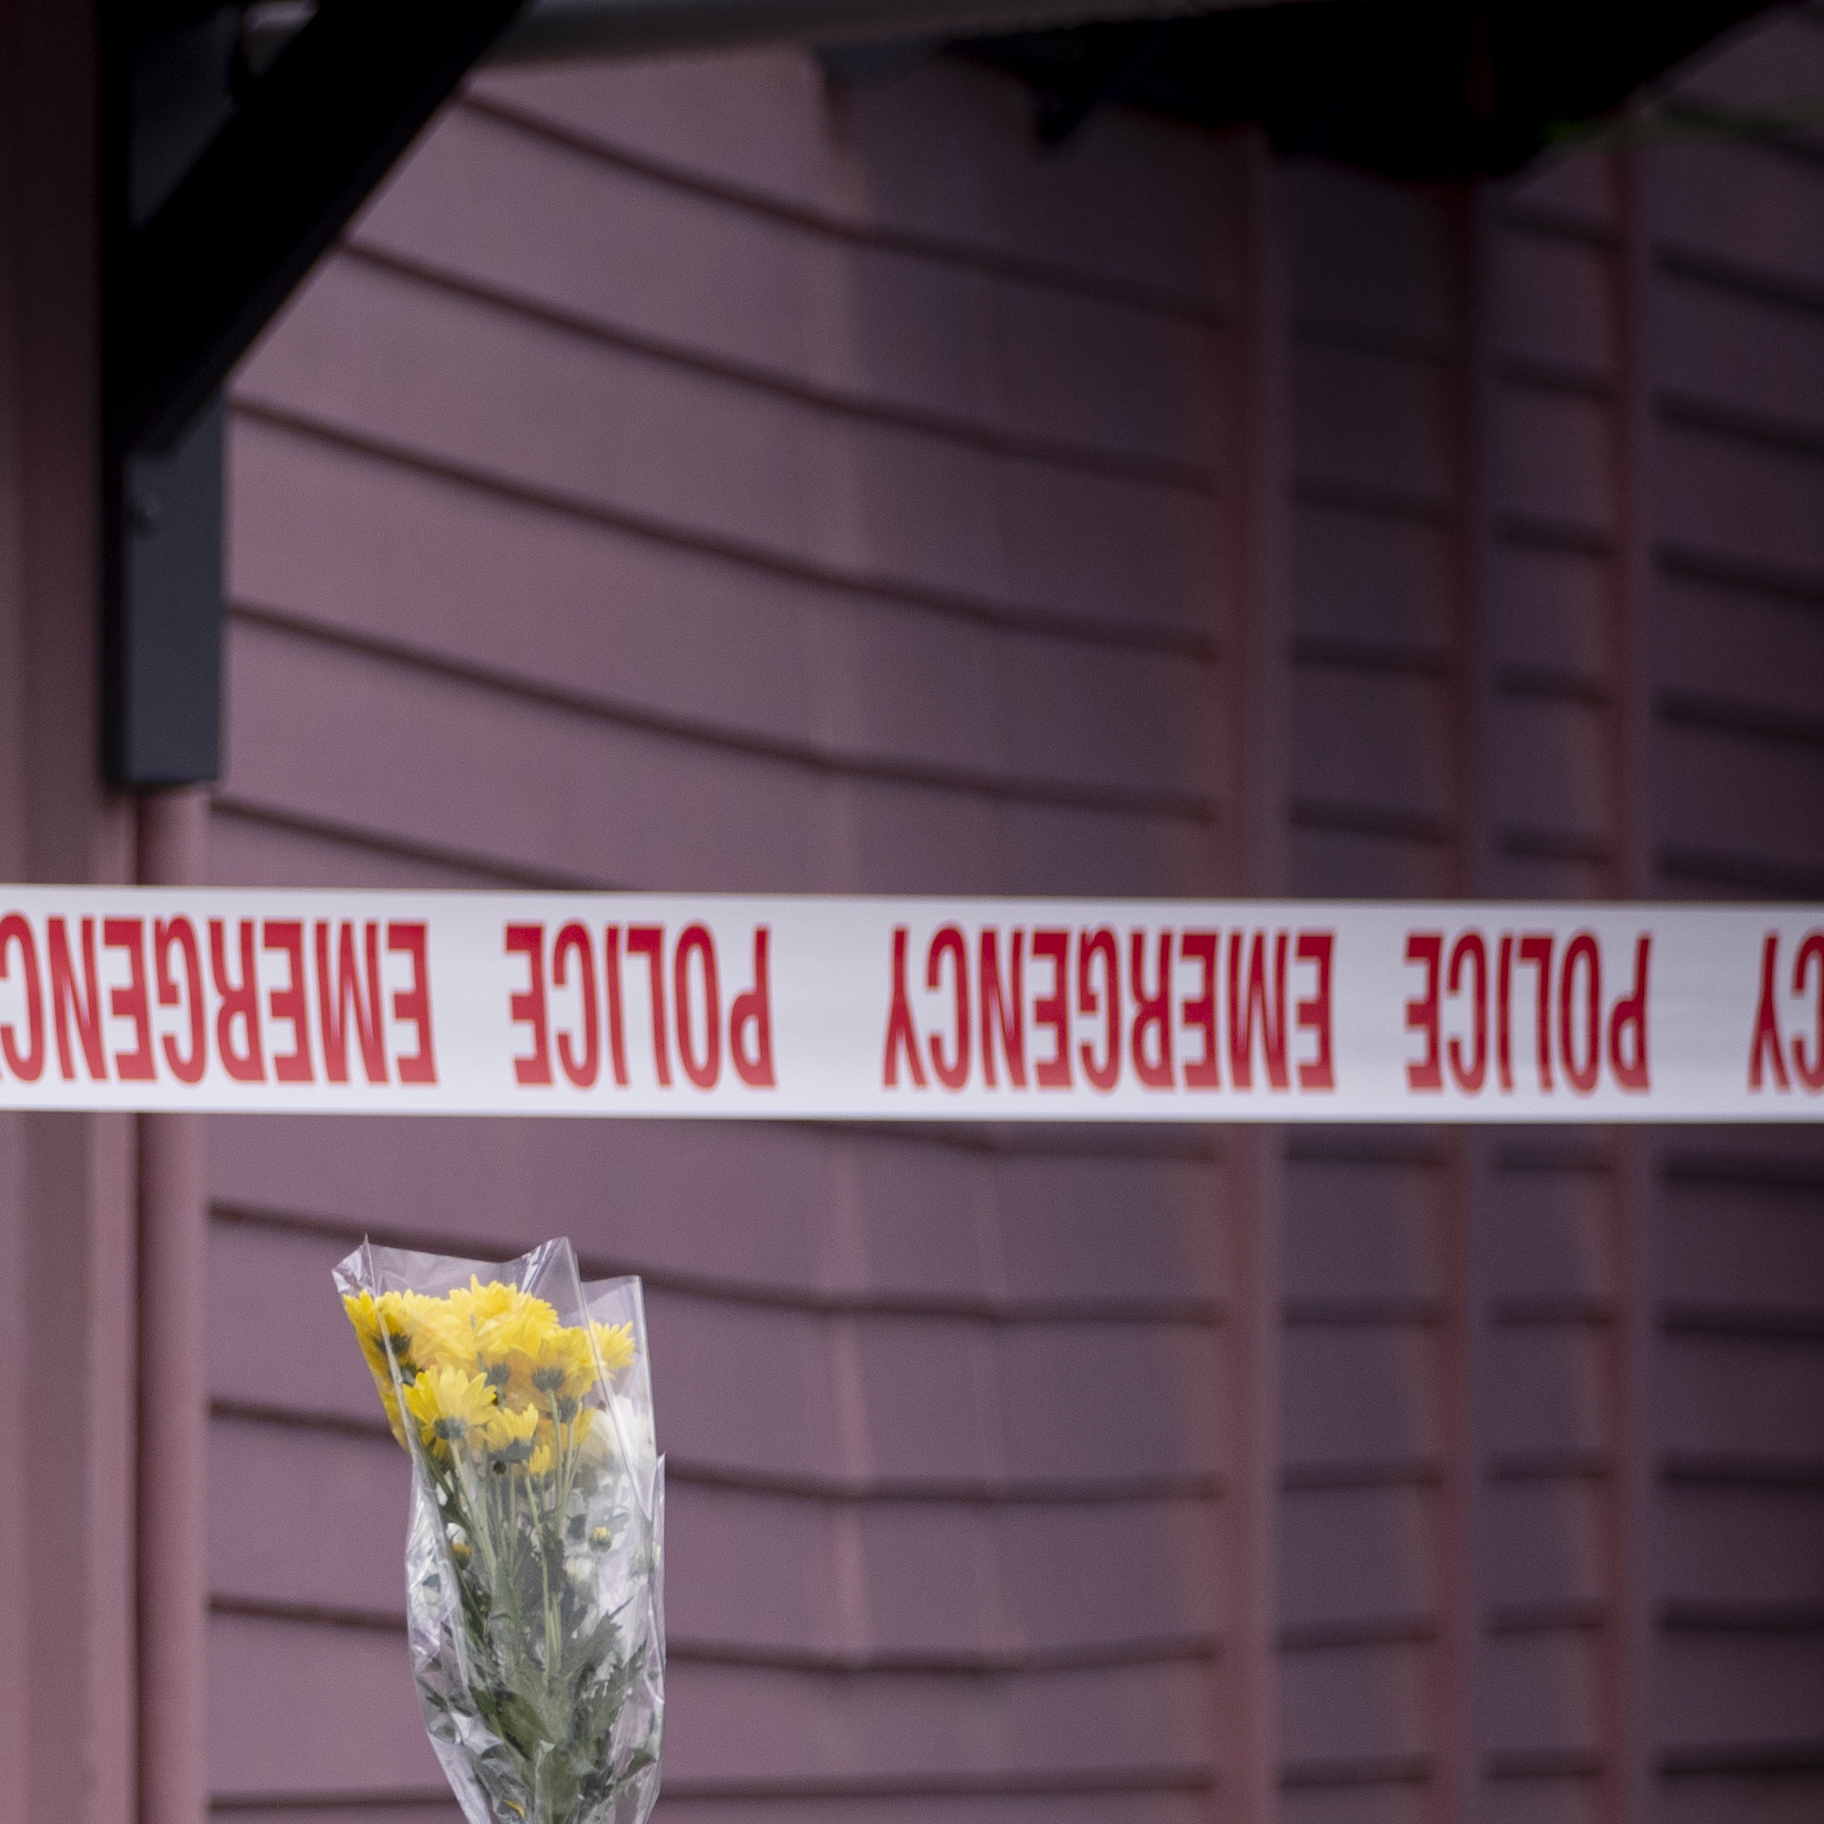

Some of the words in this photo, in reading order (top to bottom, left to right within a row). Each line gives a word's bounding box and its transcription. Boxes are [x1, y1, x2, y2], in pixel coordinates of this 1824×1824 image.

[504, 922, 775, 1089] POLICE
[883, 925, 1334, 1091] EMERGENCY
[1406, 932, 1650, 1092] POLICE
